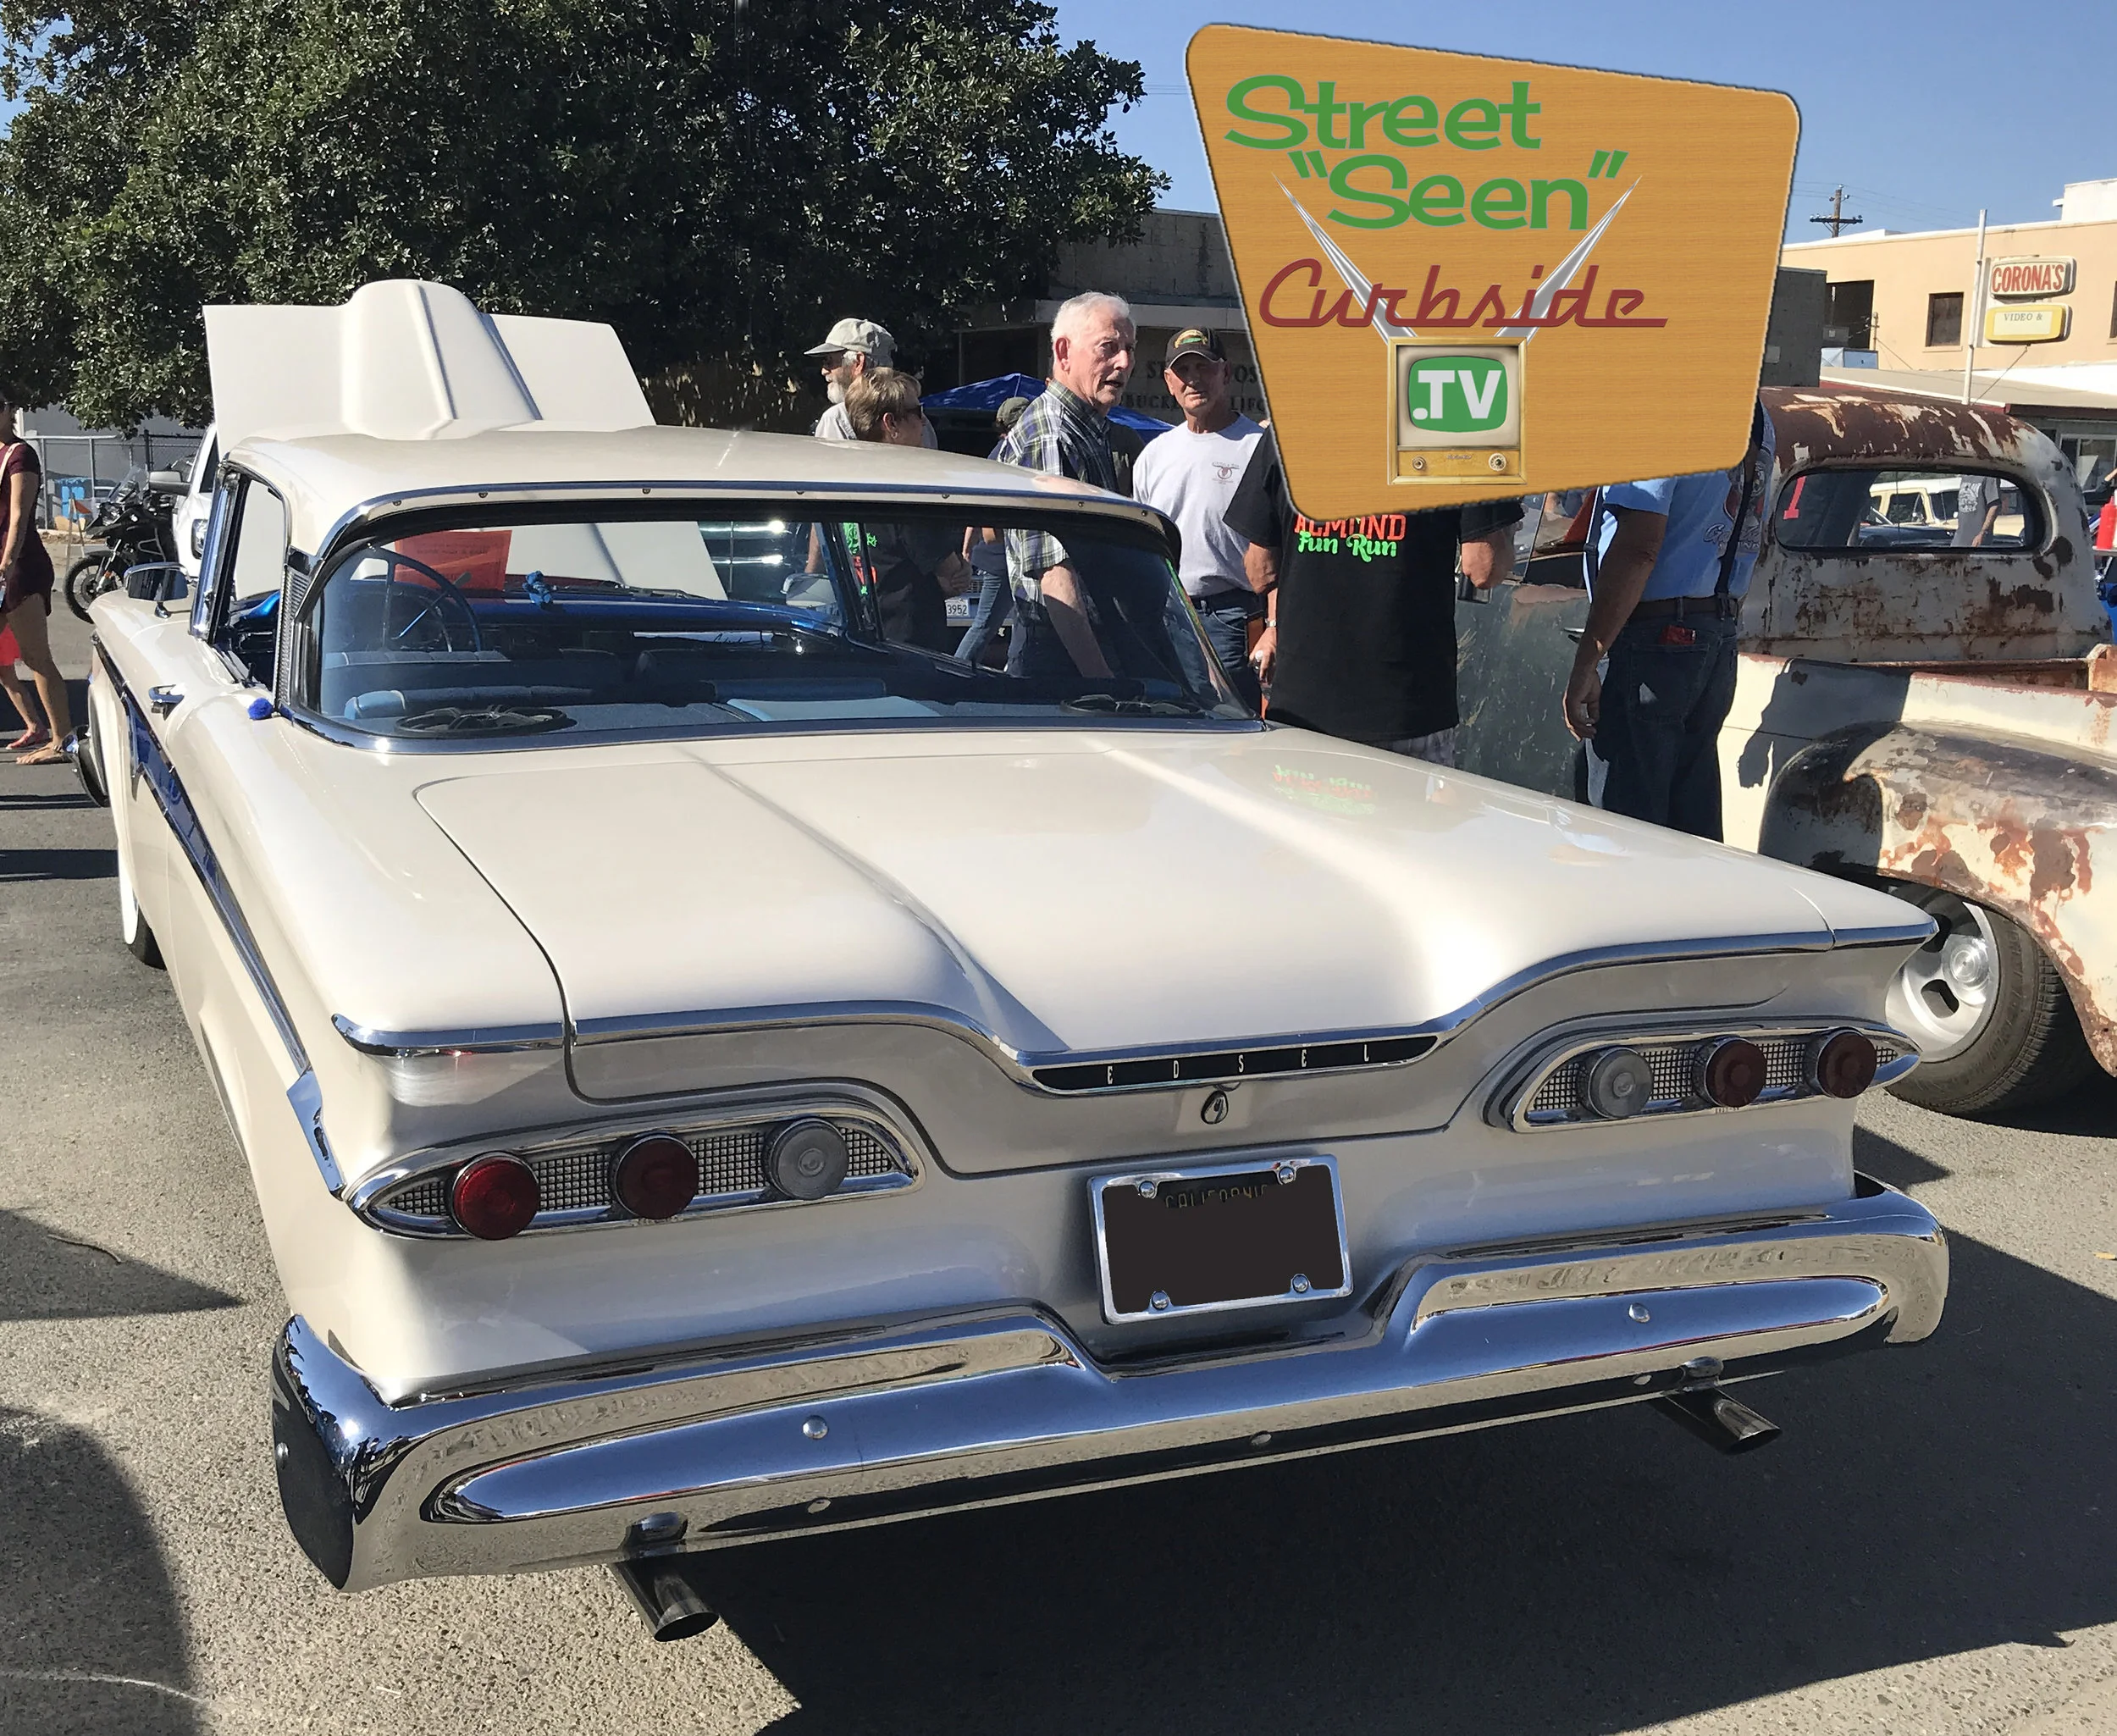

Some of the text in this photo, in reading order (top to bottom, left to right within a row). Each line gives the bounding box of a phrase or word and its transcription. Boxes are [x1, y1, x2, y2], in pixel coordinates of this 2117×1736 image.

[1992, 264, 2064, 292] CORONA'S
[1298, 531, 1397, 562] Fun Run
[1107, 1043, 1369, 1085] EDSEL
